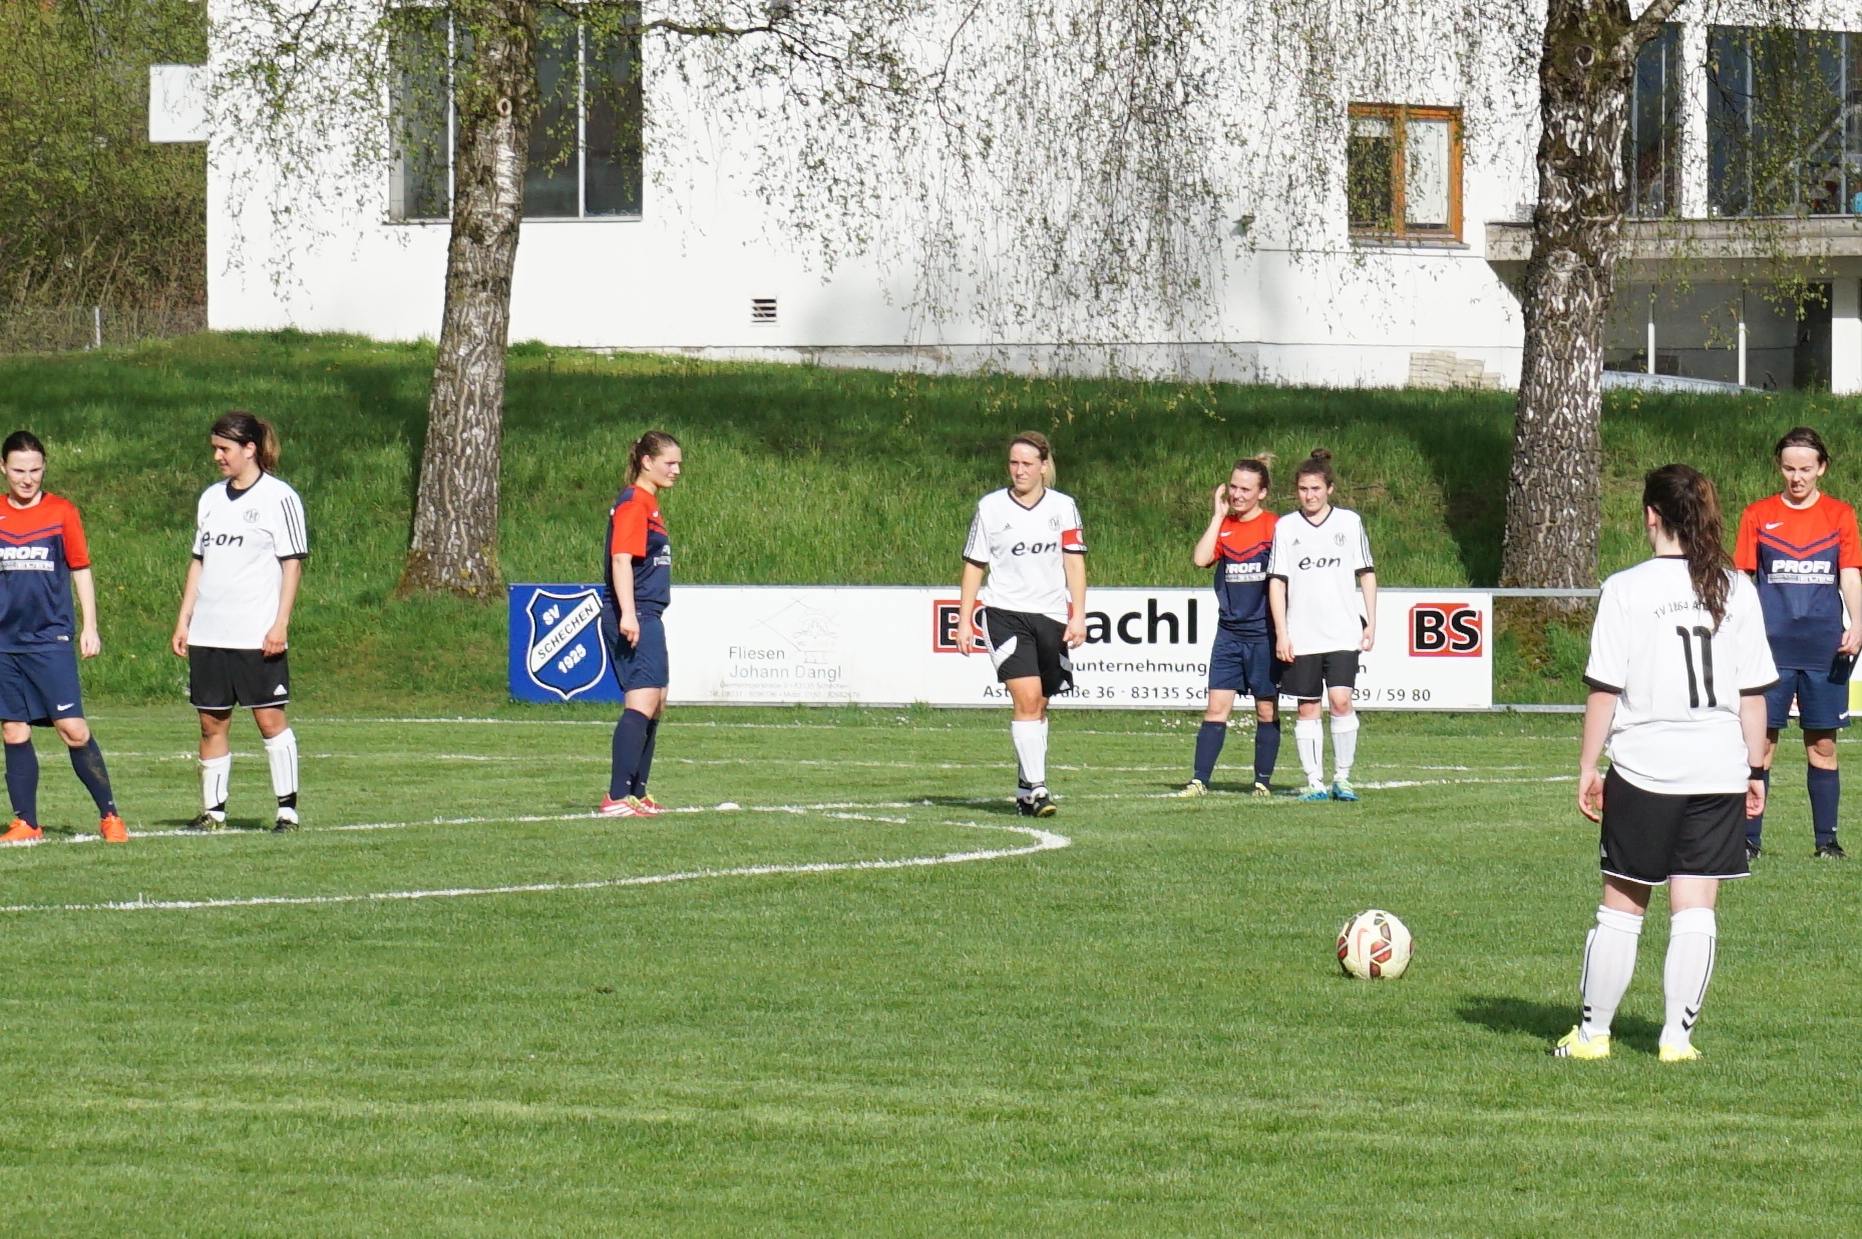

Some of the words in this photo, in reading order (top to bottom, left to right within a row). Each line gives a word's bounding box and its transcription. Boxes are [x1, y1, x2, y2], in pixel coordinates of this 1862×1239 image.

[1772, 559, 1831, 574] PROFI
[542, 603, 560, 626] SV
[537, 603, 595, 660] SCHECHEN
[1415, 610, 1480, 652] BS
[558, 643, 587, 674] 1925
[729, 645, 785, 660] Fliesen
[729, 665, 789, 679] Johann
[795, 665, 842, 683] Dangl
[1675, 625, 1717, 708] 11
[1096, 686, 1115, 699] 36
[1131, 686, 1180, 700] 83135
[1387, 688, 1406, 701] 59
[1412, 688, 1431, 701] 80
